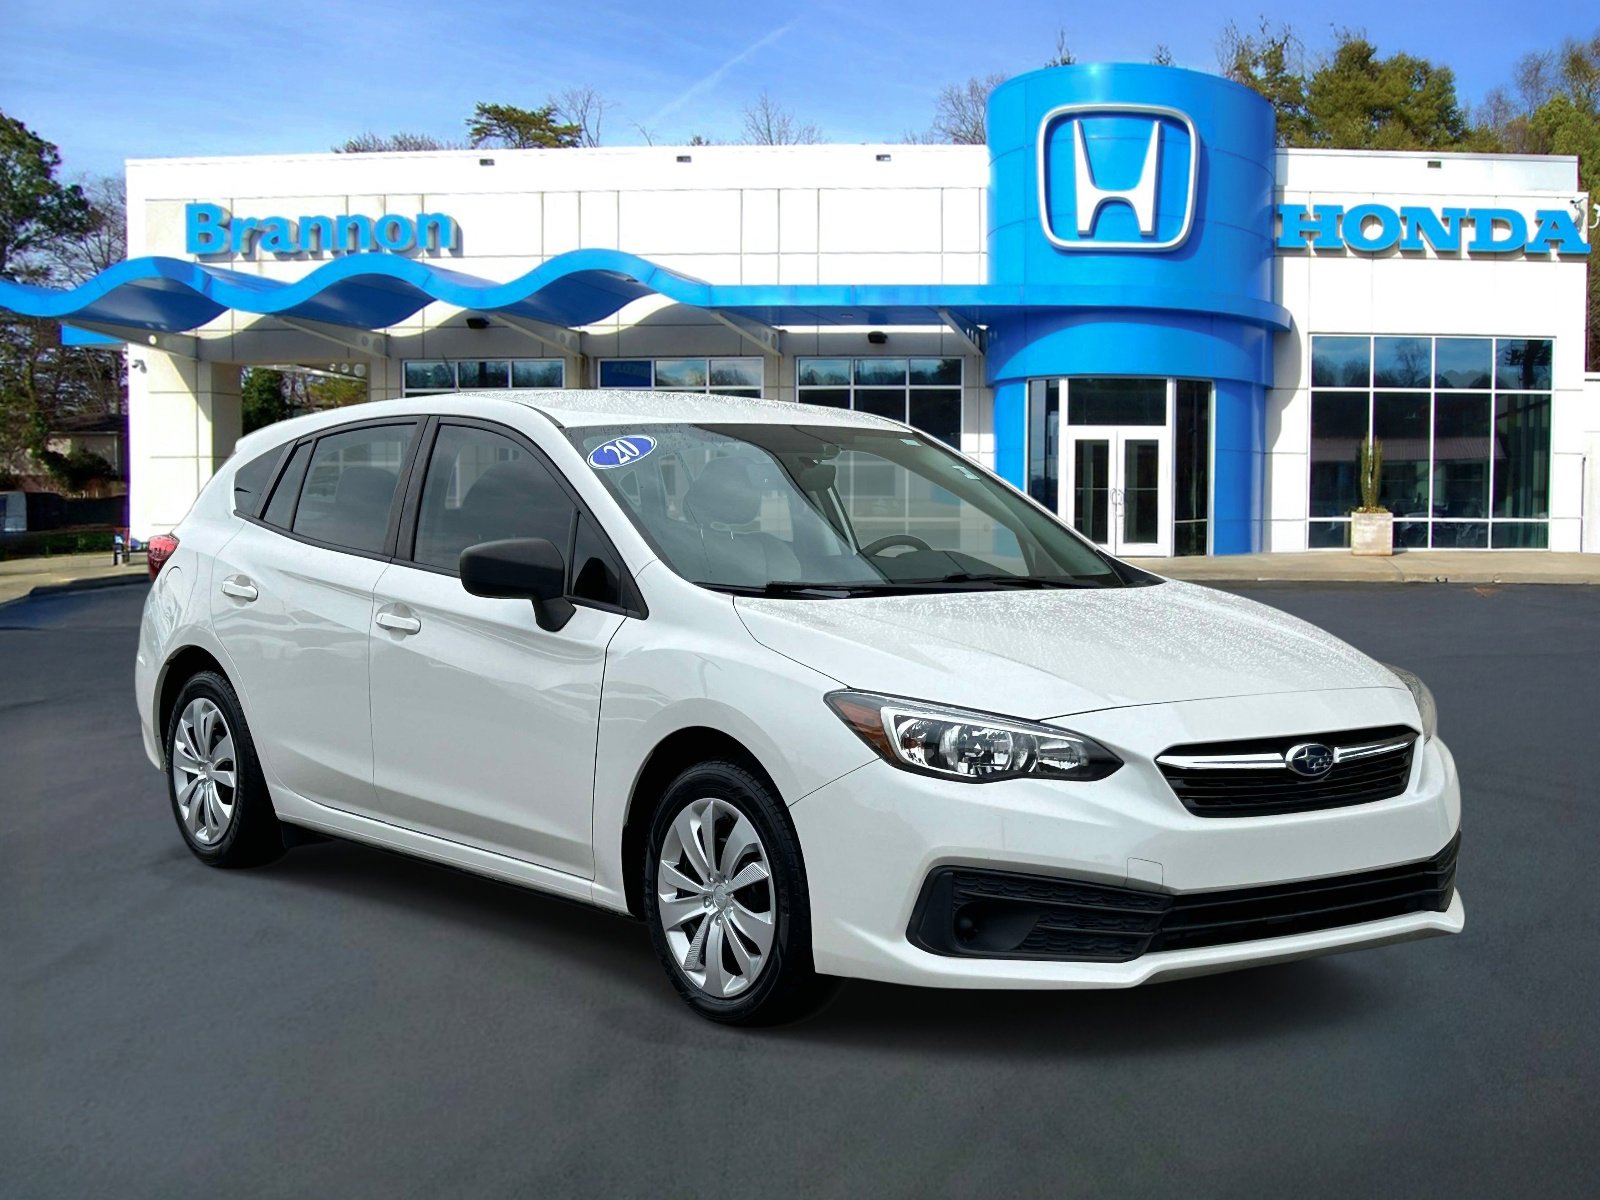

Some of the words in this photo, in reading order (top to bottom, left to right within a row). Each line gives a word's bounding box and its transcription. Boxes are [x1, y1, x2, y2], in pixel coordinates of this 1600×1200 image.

[185, 202, 460, 257] Brannon
[1276, 203, 1592, 255] HONDA
[603, 439, 640, 464] 20
